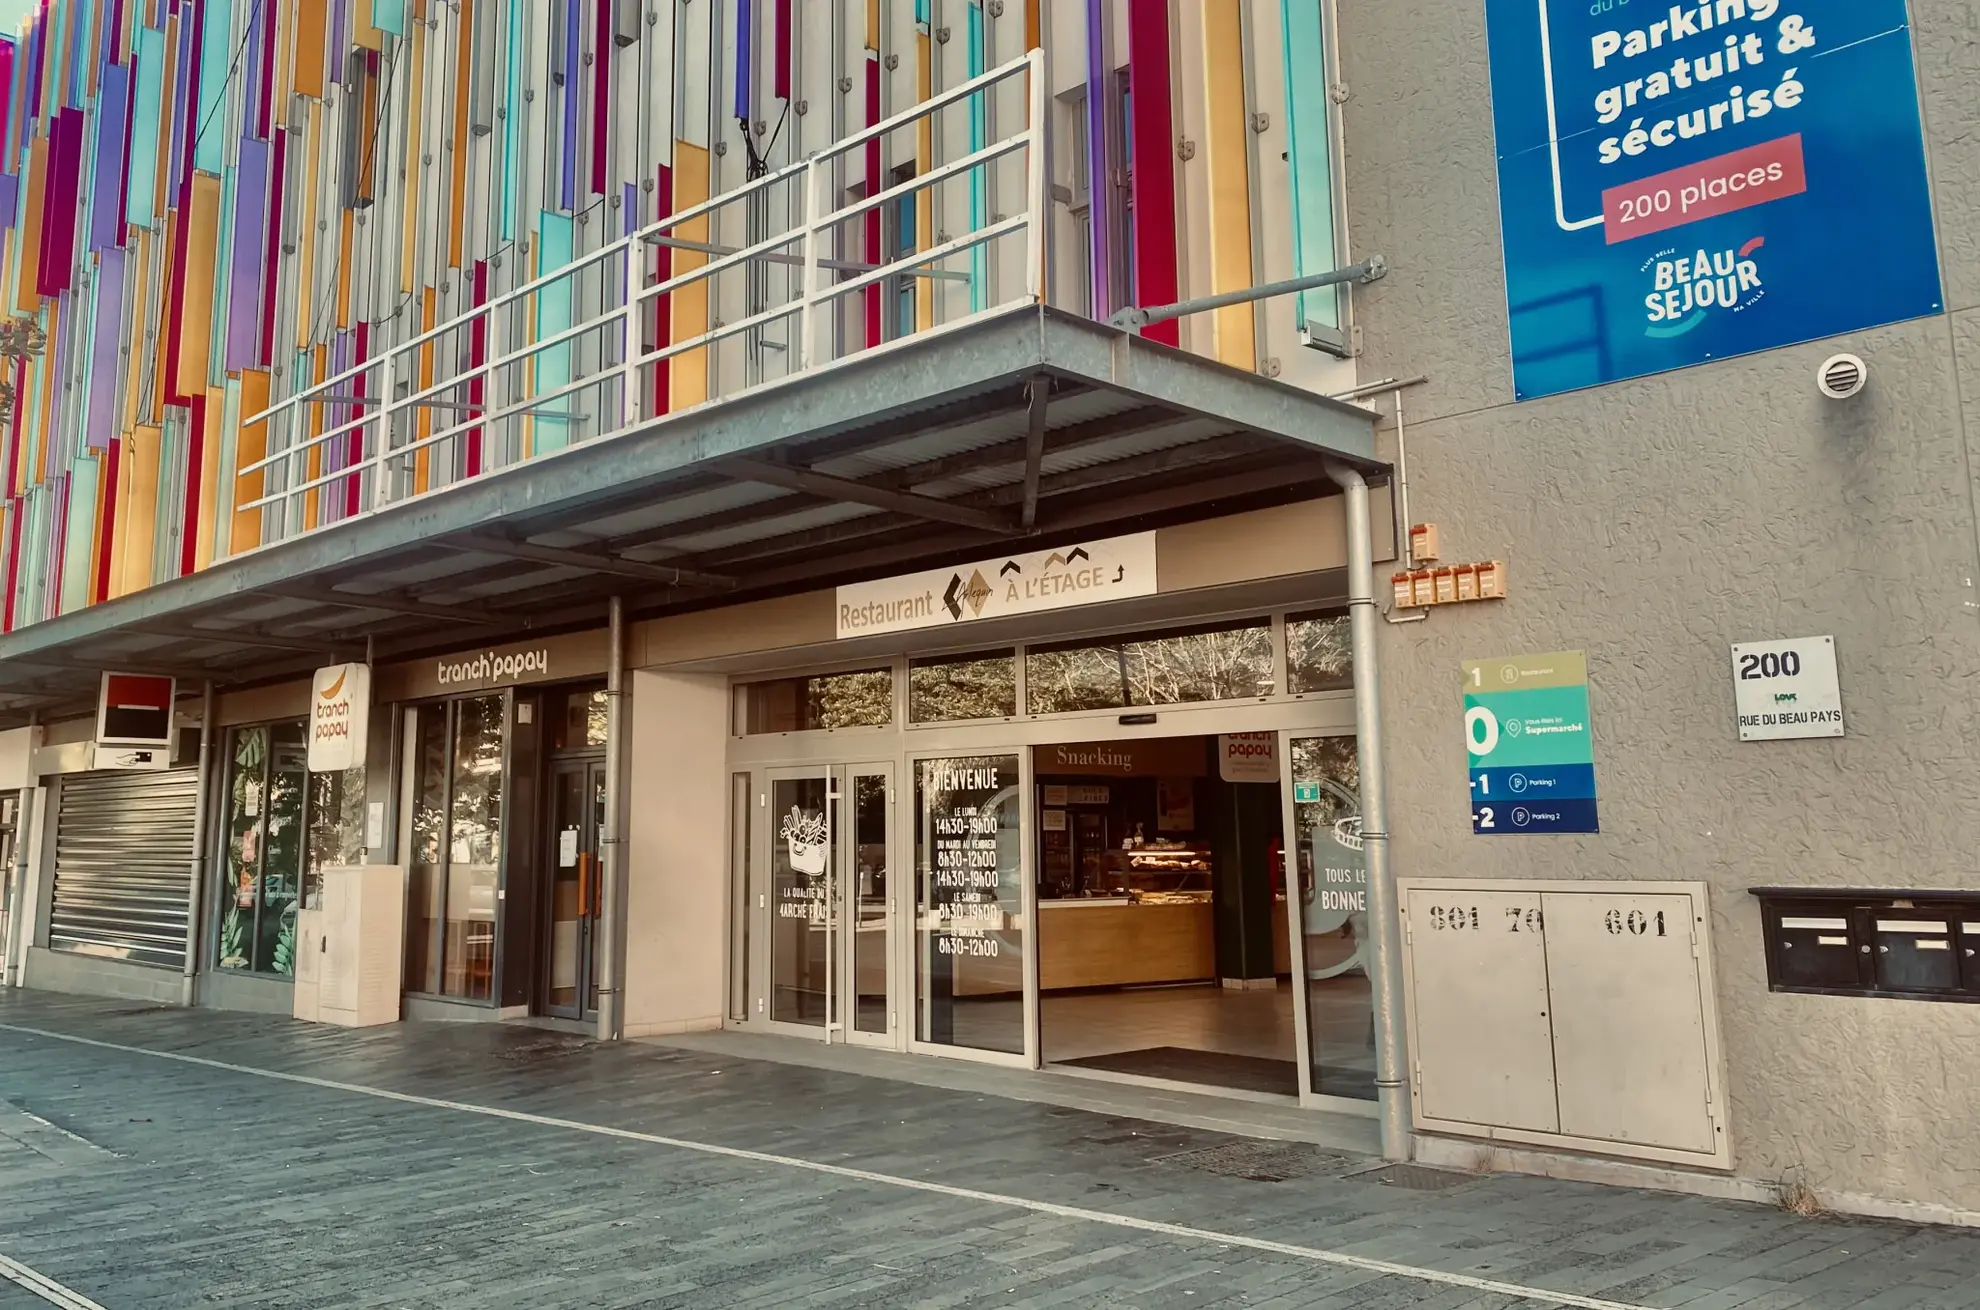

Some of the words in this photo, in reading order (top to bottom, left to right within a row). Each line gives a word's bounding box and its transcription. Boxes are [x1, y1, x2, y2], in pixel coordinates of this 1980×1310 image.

[1591, 0, 1779, 69] Parking
[1594, 33, 1764, 124] gratuit
[1777, 14, 1816, 54] &
[1598, 67, 1805, 164] sécurisé
[1619, 189, 1671, 223] 200
[1680, 162, 1783, 214] places
[1640, 256, 1655, 273] PLUS
[1655, 247, 1675, 258] BELLE
[1654, 248, 1735, 291] BEAU
[1644, 260, 1763, 322] SEJOUR
[1733, 305, 1745, 313] MA
[1746, 289, 1765, 306] VILLE
[840, 590, 933, 630] Restaurant
[1006, 578, 1020, 602] À
[437, 649, 548, 684] tranch'papay
[1471, 667, 1481, 686] 1
[1740, 651, 1800, 680] 200
[316, 697, 350, 718] tranch
[1740, 715, 1760, 726] RUE
[1762, 714, 1776, 725] DU
[1779, 712, 1808, 725] BEAU
[1811, 710, 1841, 722] PAYS
[315, 720, 349, 744] papay
[1525, 722, 1583, 736] Supermarché
[1057, 746, 1132, 771] Snacking
[1228, 743, 1272, 760] papay
[933, 768, 999, 791] BIENVENUE
[1529, 779, 1552, 787] Parking
[954, 807, 961, 817] LE
[1532, 812, 1555, 821] Parking
[935, 817, 998, 835] 14h30-19h00
[937, 850, 997, 868] 8h30-12h00
[936, 870, 998, 888] 14h30-19h00
[1325, 868, 1351, 883] TOUS
[1355, 868, 1366, 884] LE
[783, 887, 791, 897] LA
[953, 892, 960, 902] LE
[1321, 890, 1366, 912] BONNE
[1430, 906, 1479, 930] 801
[1604, 909, 1667, 937] 601
[939, 938, 998, 957] 8h30-12h00
